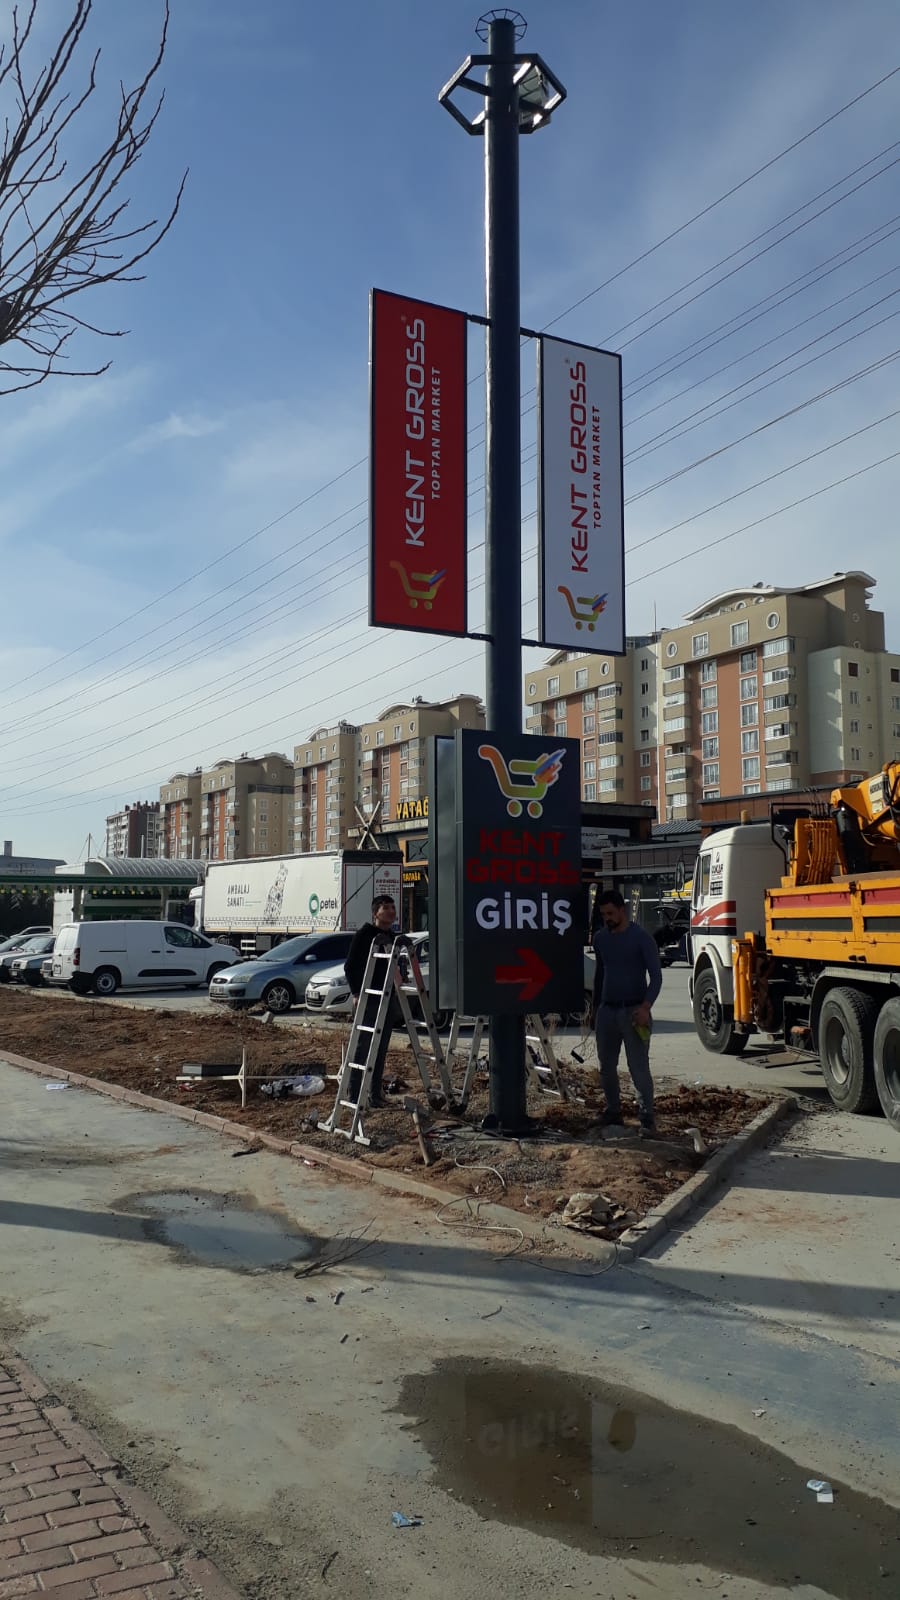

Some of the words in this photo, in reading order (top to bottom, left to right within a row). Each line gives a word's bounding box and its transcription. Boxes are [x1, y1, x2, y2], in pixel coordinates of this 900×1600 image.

[405, 318, 425, 441] GROSS
[431, 367, 441, 432] MARKET
[570, 361, 587, 474] GROSS
[592, 406, 601, 466] MARKET
[405, 450, 425, 547] KENT
[431, 438, 441, 500] TOPTAN
[571, 483, 588, 573] KENT
[593, 472, 601, 529] TOPTAN
[466, 858, 579, 885] GROSS
[479, 828, 567, 857] KENT
[227, 883, 250, 895] AMBALAJ
[475, 891, 573, 936] GİRİŞ
